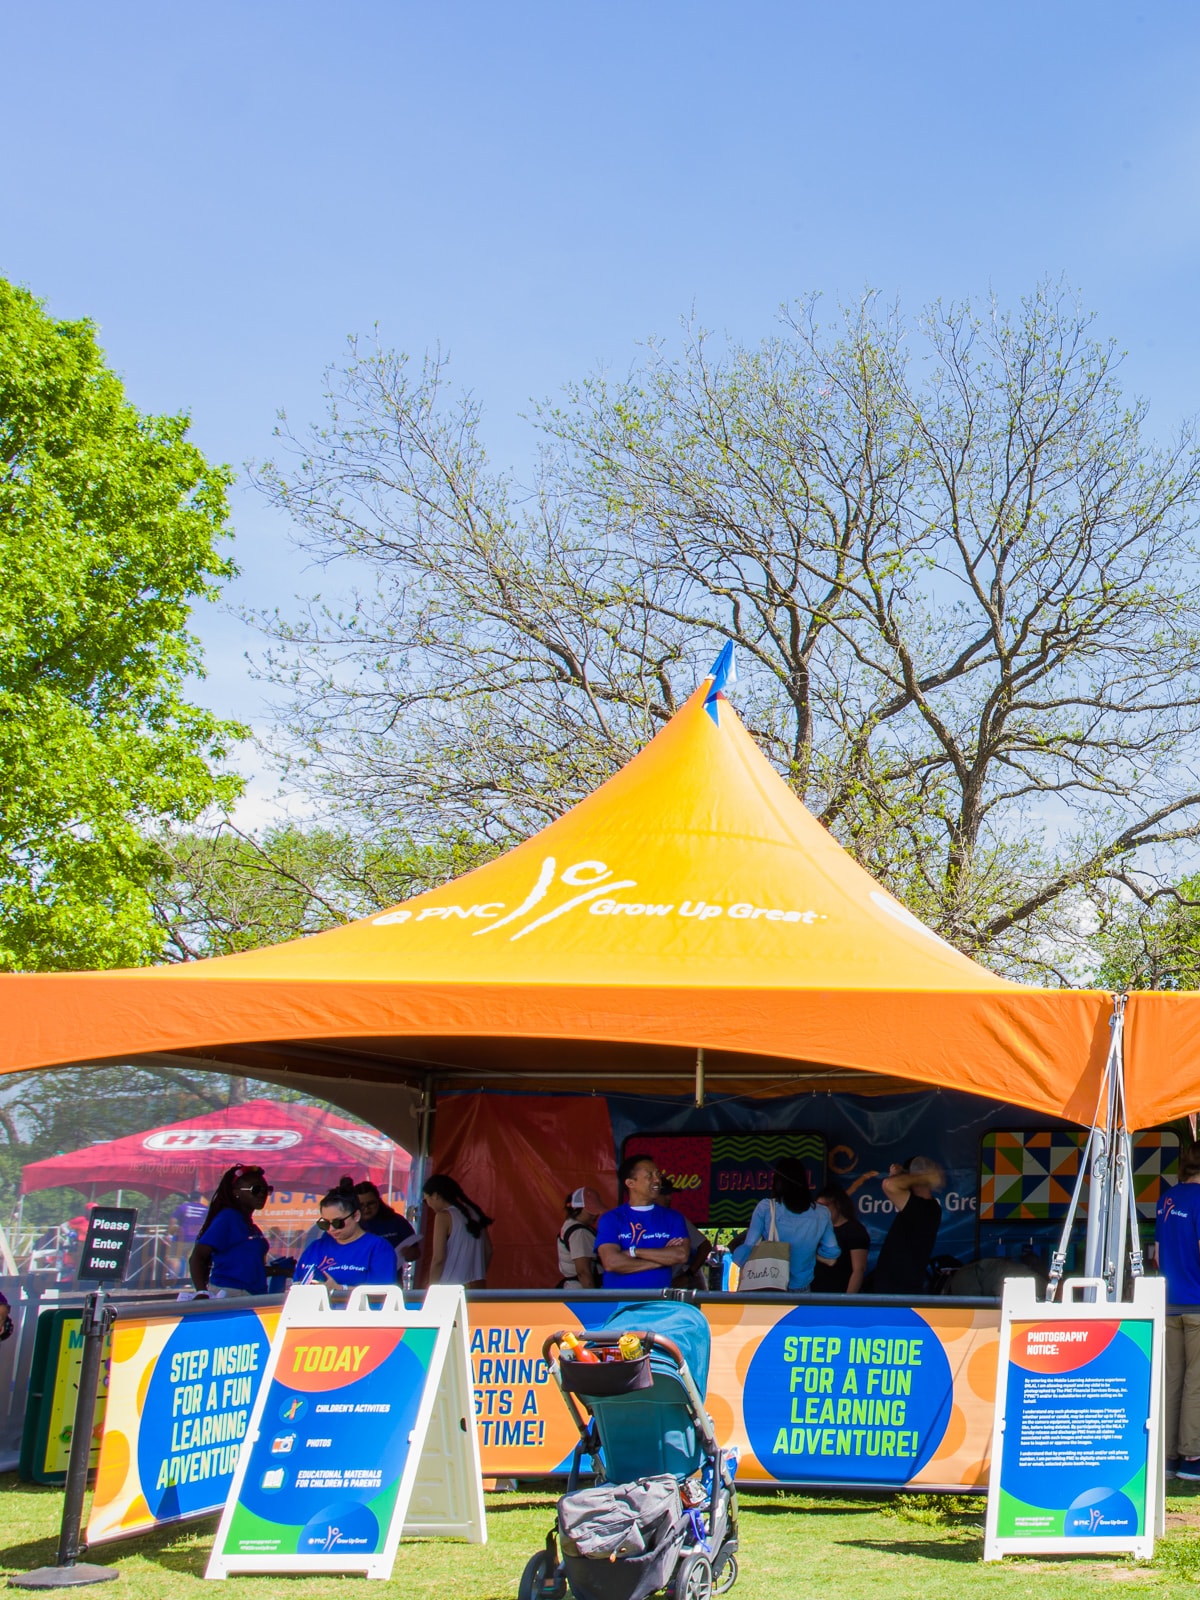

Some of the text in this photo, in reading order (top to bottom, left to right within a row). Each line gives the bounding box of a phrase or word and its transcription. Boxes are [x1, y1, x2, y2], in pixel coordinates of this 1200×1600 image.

[415, 902, 506, 922] PNC
[589, 900, 818, 924] Grow Up Great
[945, 1192, 976, 1211] Gre
[93, 1219, 130, 1231] Please
[92, 1238, 123, 1249] Enter
[90, 1257, 118, 1269] Here
[470, 1329, 531, 1354] ARLY
[1027, 1331, 1089, 1343] PHOTOGRAPHY
[292, 1345, 371, 1373] TODAY
[783, 1336, 923, 1365] STEP INSIDE
[1026, 1344, 1060, 1355] NOTICE:
[170, 1342, 260, 1383] STEP INSIDE
[789, 1366, 912, 1395] FOR A FUN
[172, 1376, 252, 1417] FOR A FUN
[315, 1404, 391, 1412] CHILDREN'S ACTIVITIES
[474, 1389, 539, 1415] STS A
[790, 1397, 906, 1426] LEARNING
[170, 1410, 248, 1452] LEARNING
[306, 1439, 332, 1447] PHOTOS
[480, 1420, 545, 1446] TIME!
[772, 1427, 919, 1457] ADVENTURE!
[155, 1443, 242, 1490] ADVENTUR
[297, 1470, 382, 1479] EDUCATIONAL MATERIALS
[295, 1479, 381, 1488] FOR CHILDREN & PARENTS
